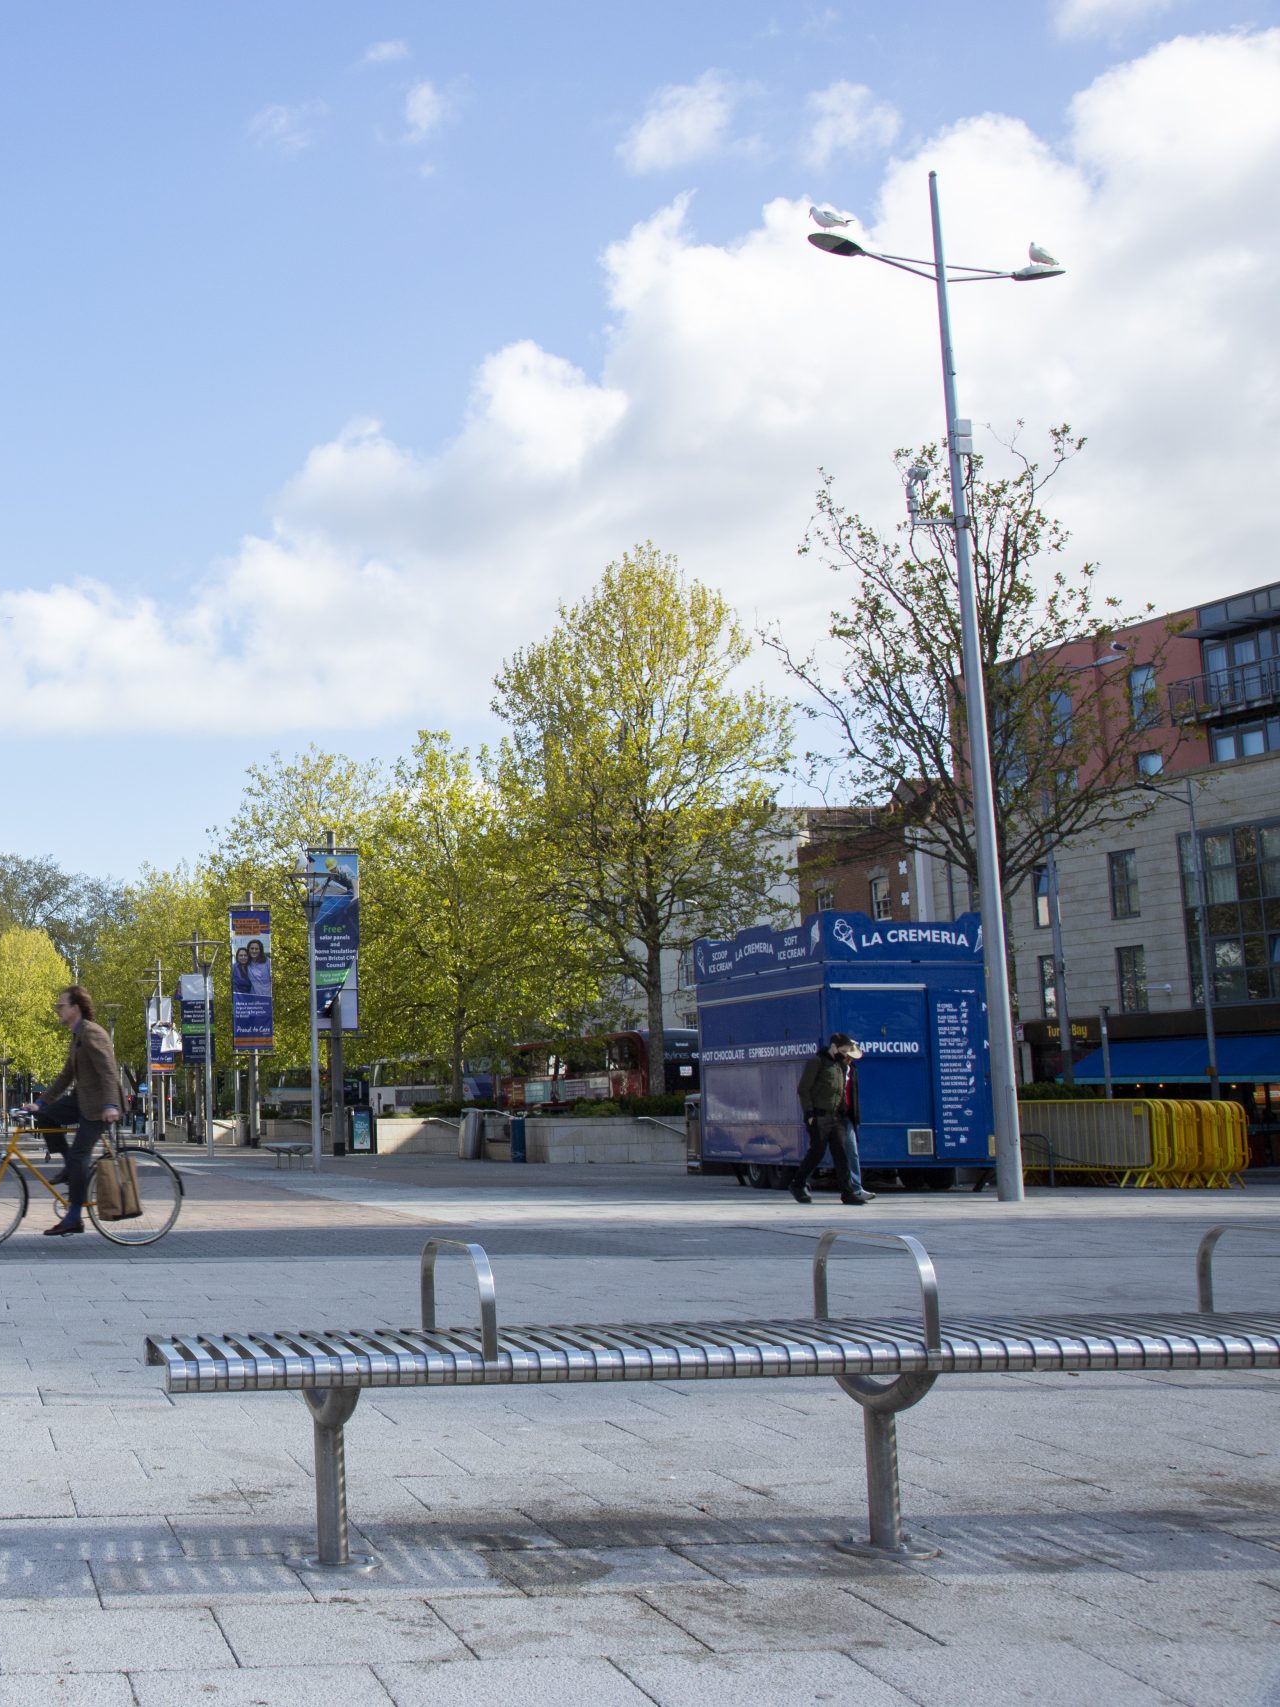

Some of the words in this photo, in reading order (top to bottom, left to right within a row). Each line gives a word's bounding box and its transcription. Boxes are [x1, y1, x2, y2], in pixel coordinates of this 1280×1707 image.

[784, 935, 798, 947] SOFT
[862, 932, 883, 947] LA
[887, 929, 969, 947] CREMERIA
[712, 950, 728, 961] SCOOP
[735, 948, 743, 962] LA
[743, 942, 774, 957] CREMERIA
[777, 951, 786, 961] ICE
[786, 946, 807, 959] CREAM
[708, 963, 717, 974] ICE
[717, 961, 733, 973] CREAM
[236, 1025, 251, 1033] Proud
[259, 1025, 270, 1033] Care
[1071, 1023, 1088, 1039] Bay
[748, 1046, 775, 1059] ESPRESSO
[780, 1042, 817, 1056] CAPPUCCINO
[859, 1041, 919, 1053] APPUCCINO
[701, 1051, 714, 1062] HOT
[714, 1049, 745, 1061] CHOCOLATE
